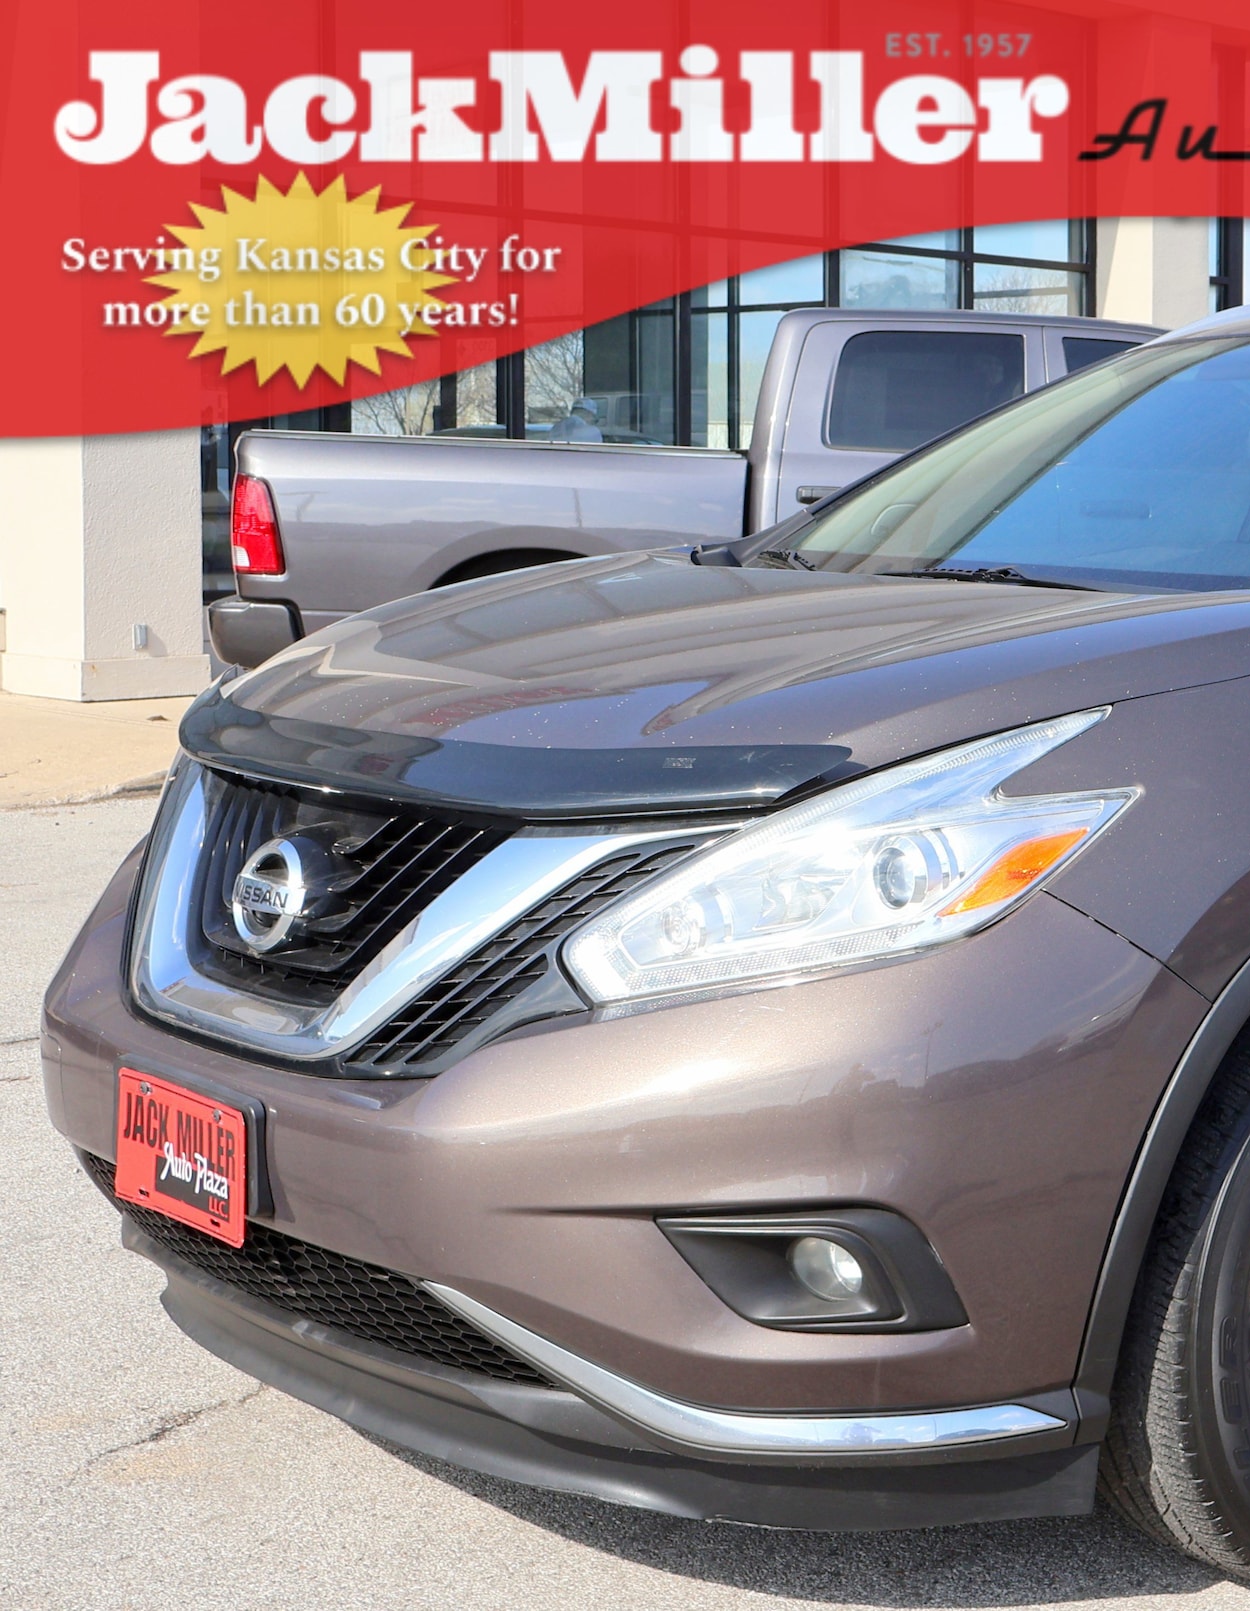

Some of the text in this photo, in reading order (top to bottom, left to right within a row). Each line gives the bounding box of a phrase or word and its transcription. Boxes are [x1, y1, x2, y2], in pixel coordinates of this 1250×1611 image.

[123, 1092, 237, 1183] JACK MILLER
[159, 1141, 229, 1200] Auto Plaza
